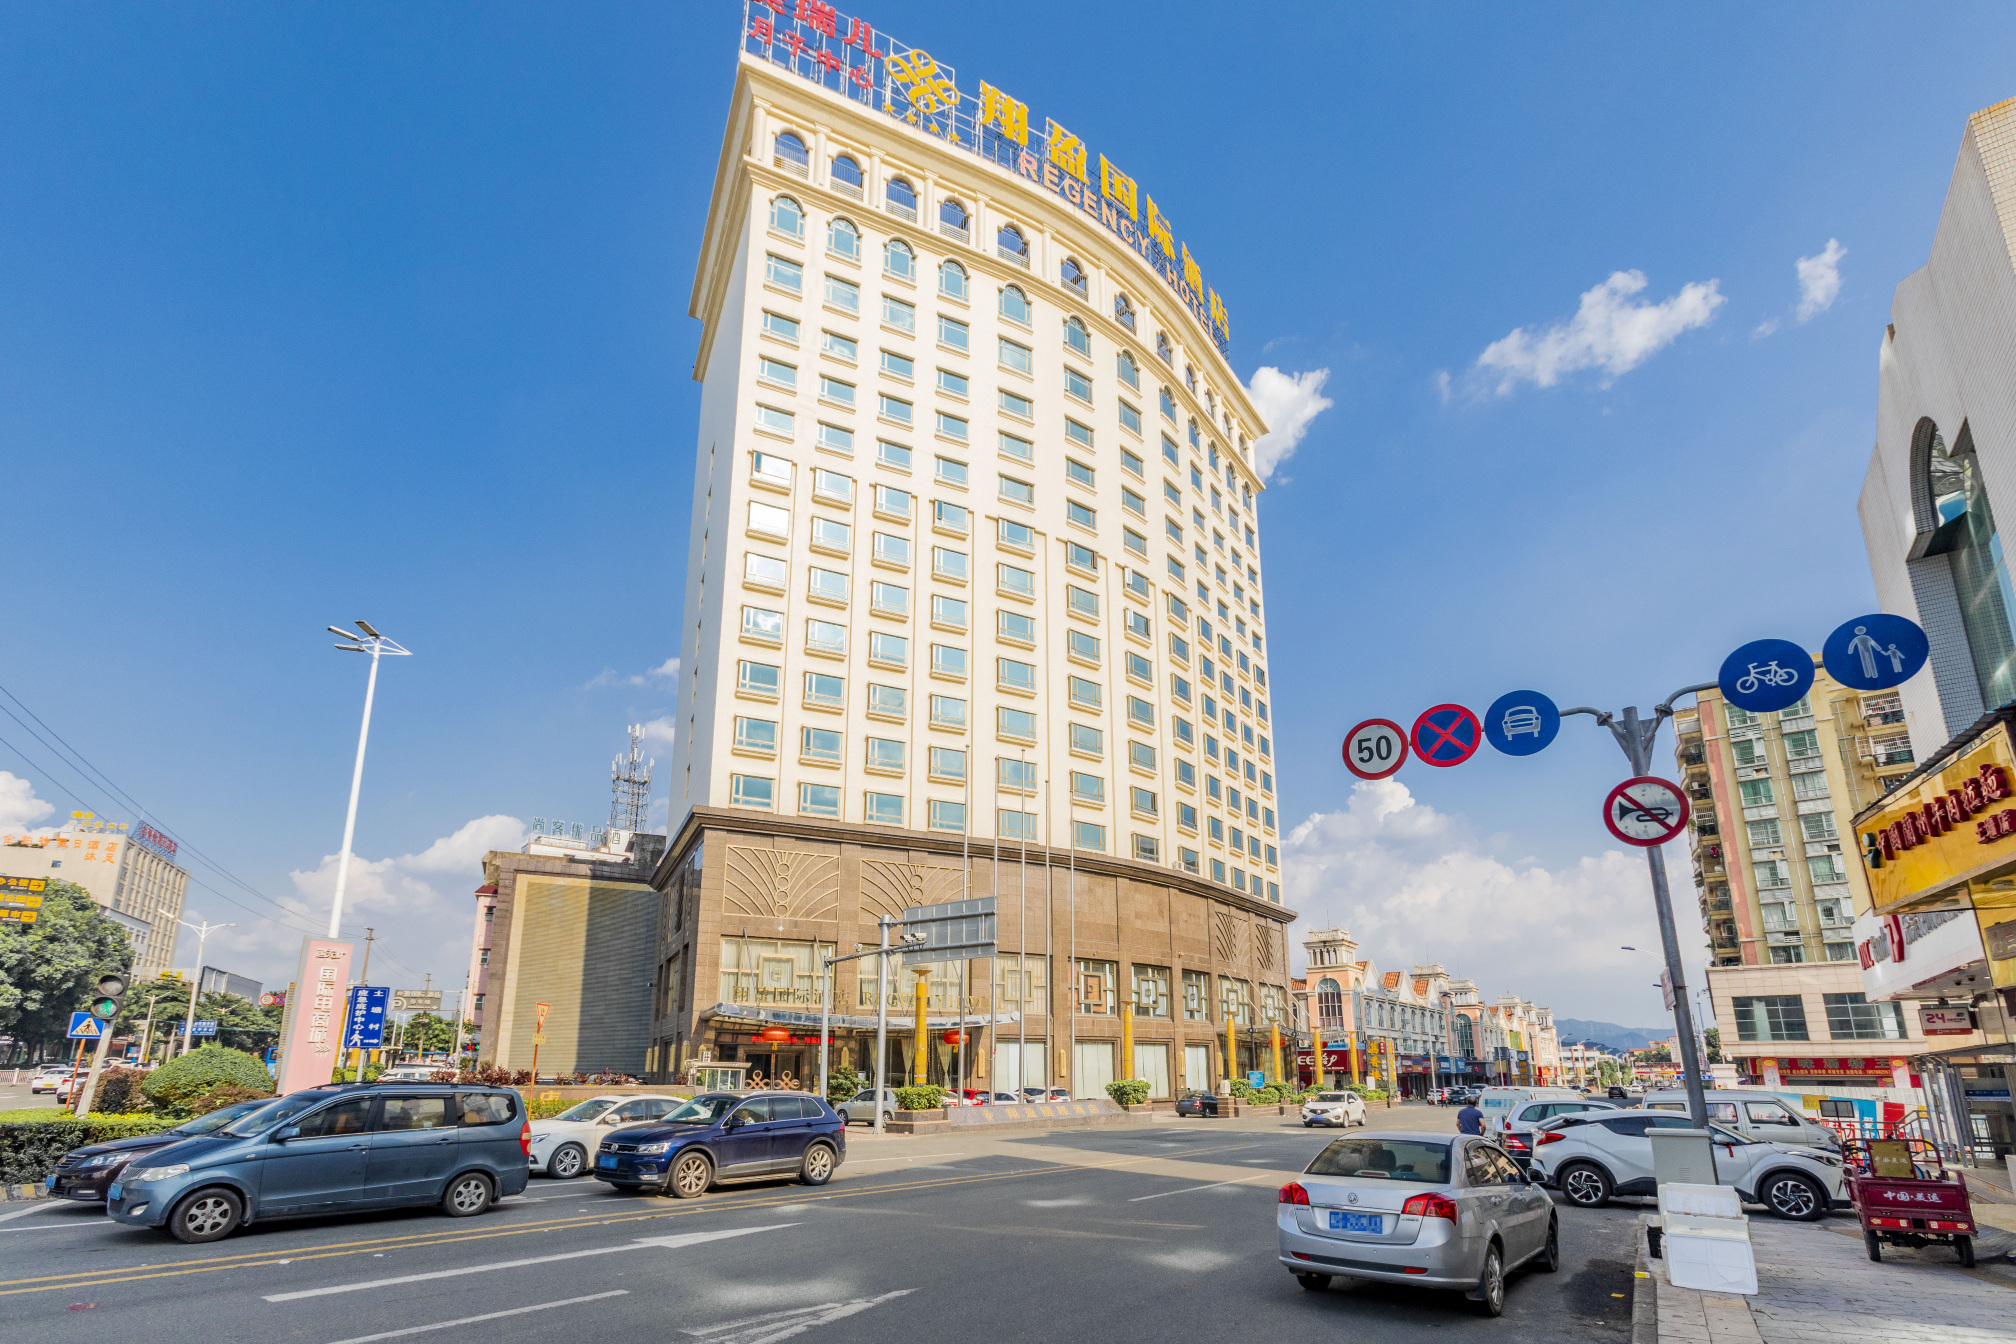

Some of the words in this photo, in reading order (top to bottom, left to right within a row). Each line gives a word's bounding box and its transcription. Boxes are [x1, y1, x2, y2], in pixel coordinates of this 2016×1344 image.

[749, 15, 874, 89] 月子中心
[979, 79, 1230, 342] 翔盈国际酒店
[1020, 151, 1149, 258] REGENCY
[1166, 262, 1219, 347] HOTEL
[1357, 737, 1393, 764] 50
[84, 852, 116, 864] 沐足
[352, 989, 370, 1031] 应急庇护中心
[368, 989, 385, 1031] 土塘村
[1926, 1013, 1947, 1024] 24
